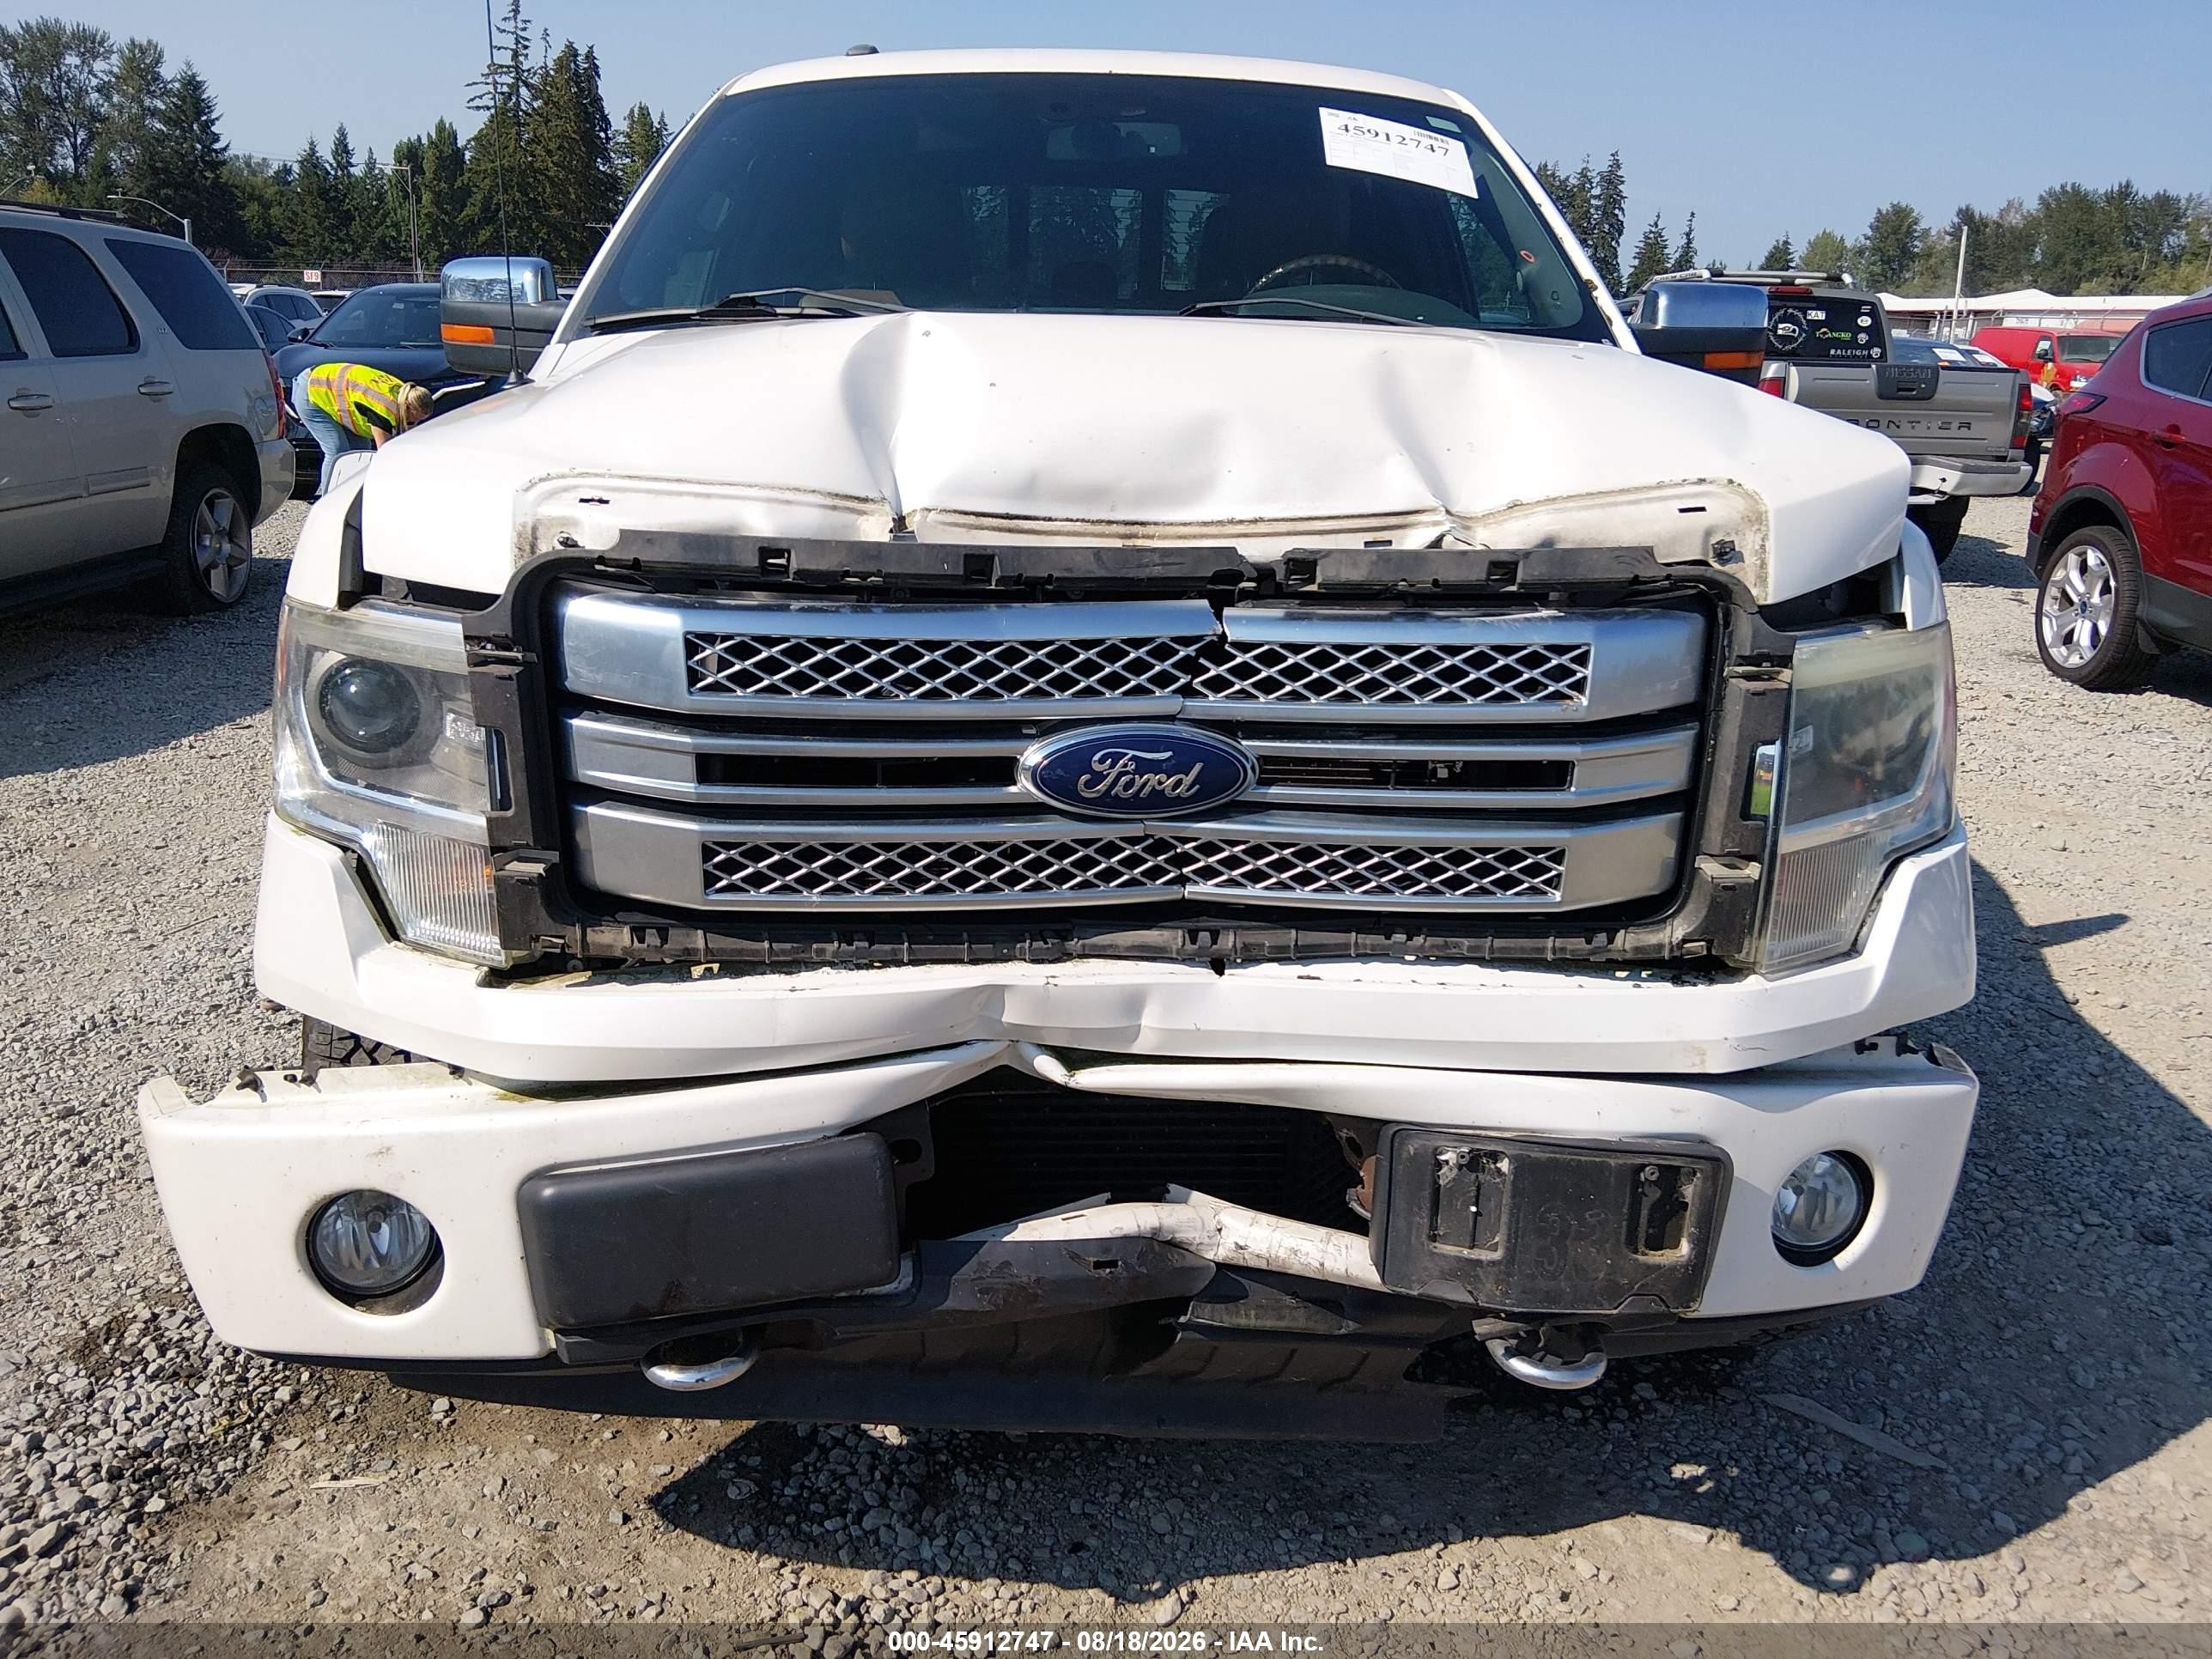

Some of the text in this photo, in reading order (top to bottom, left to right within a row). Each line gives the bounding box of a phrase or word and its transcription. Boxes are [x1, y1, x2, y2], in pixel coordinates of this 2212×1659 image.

[1337, 124, 1449, 157] 45912747
[1807, 311, 1826, 319] KAT
[1885, 367, 1932, 380] NISSAN
[1845, 418, 1972, 431] RONTIER
[1078, 748, 1204, 799] Ford
